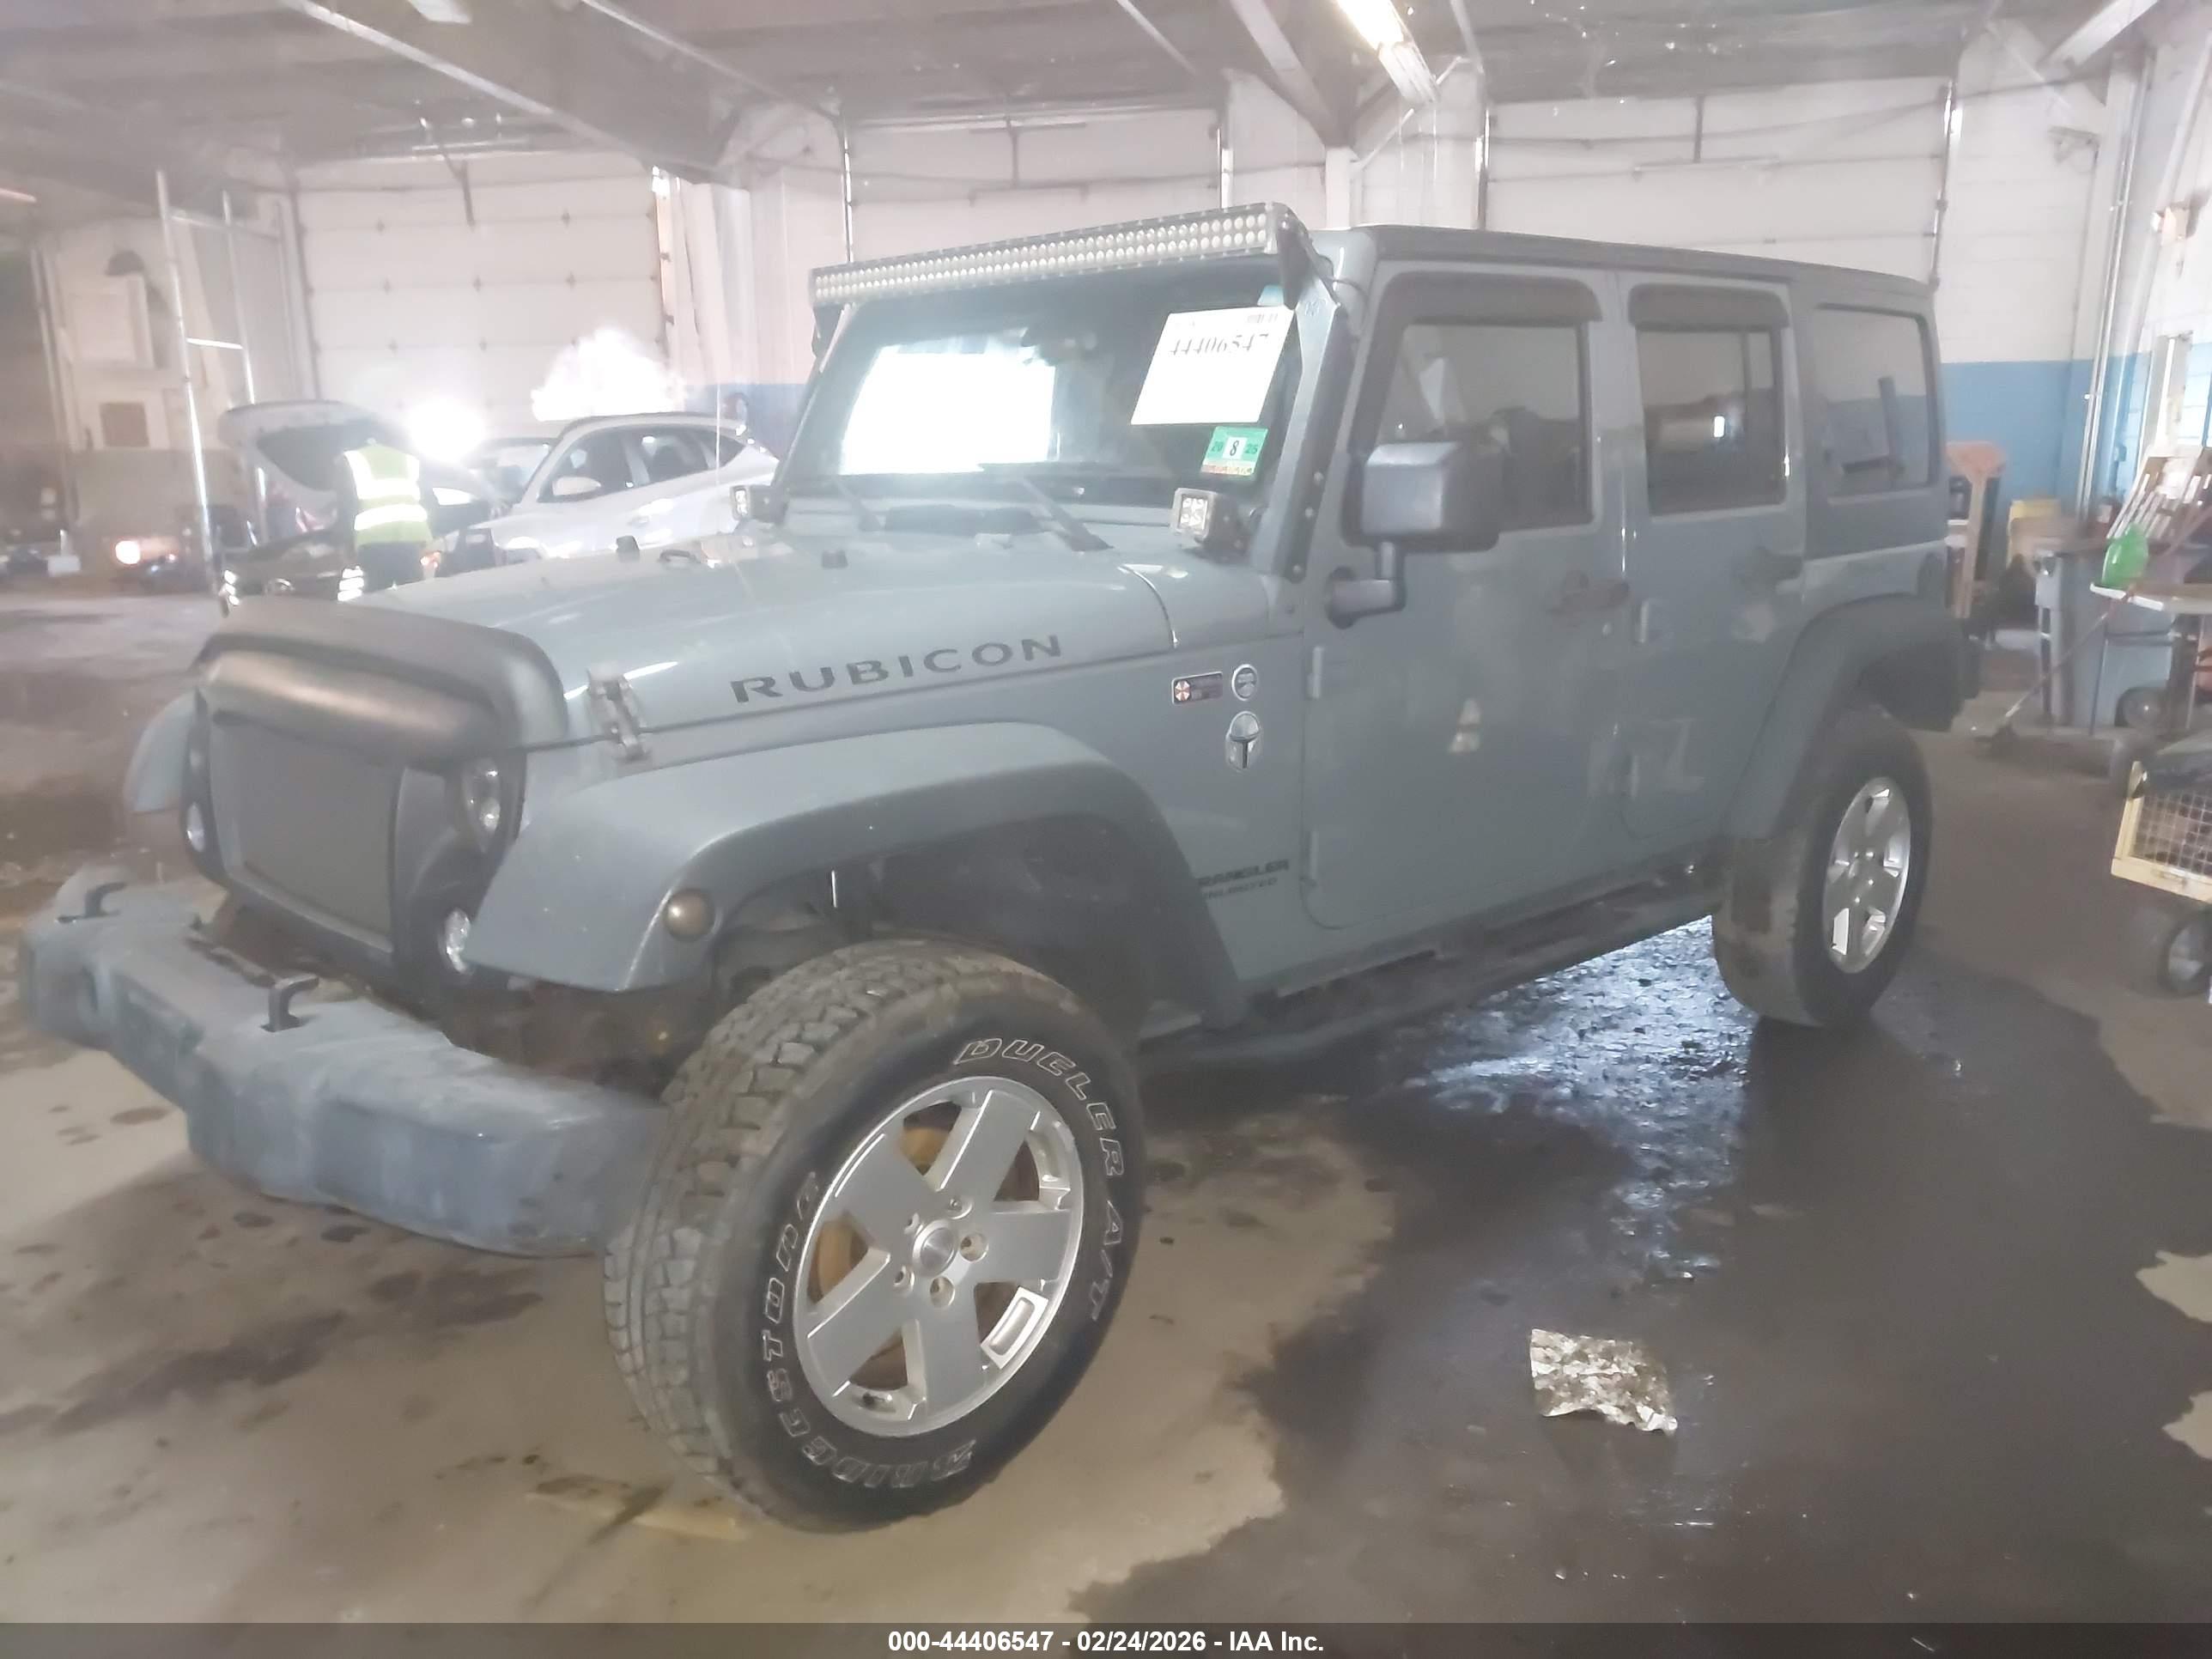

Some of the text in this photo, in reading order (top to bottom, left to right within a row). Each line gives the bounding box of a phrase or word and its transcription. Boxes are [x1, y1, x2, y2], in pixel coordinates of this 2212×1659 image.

[1230, 440, 1240, 456] 8
[730, 635, 1062, 703] RUBICON
[1197, 859, 1290, 887] RANGLER
[953, 1036, 1126, 1177] DUELER
